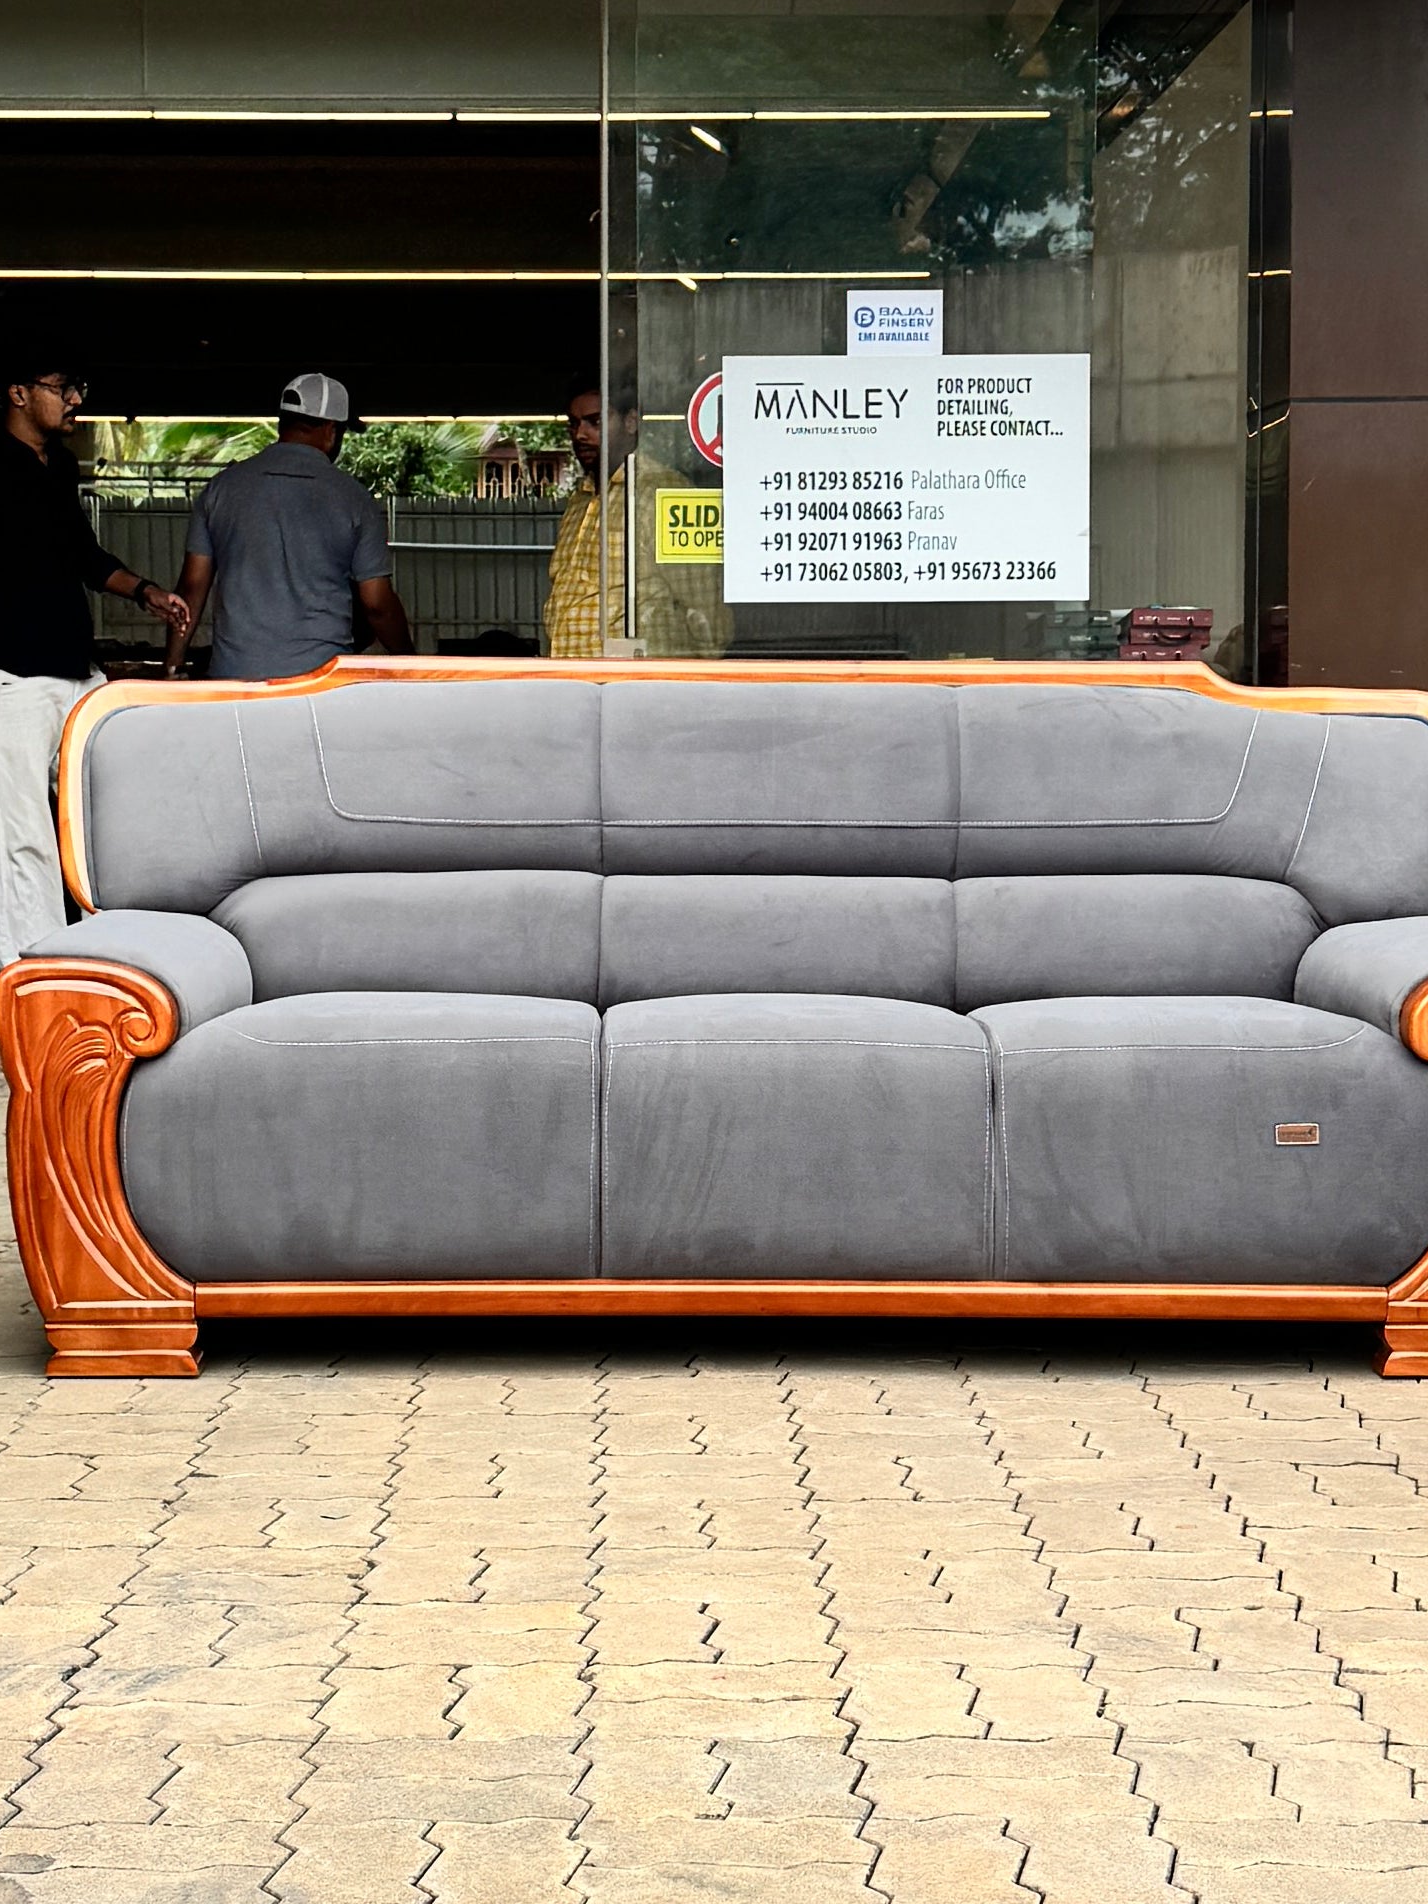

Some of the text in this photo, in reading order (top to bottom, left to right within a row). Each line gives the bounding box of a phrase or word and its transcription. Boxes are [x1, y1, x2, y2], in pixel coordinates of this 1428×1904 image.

[878, 306, 934, 317] BAJAJ
[878, 317, 934, 328] FINSERV
[858, 332, 930, 342] EMI AVAILABLE
[937, 377, 1033, 395] FOR PRODUCT
[754, 388, 909, 420] MANLEY
[937, 398, 1013, 418] DETAILING,
[785, 426, 878, 435] FURNITURE STUDIO
[937, 419, 1064, 437] PLEASE CONTACT...
[759, 468, 1027, 491] +91 81293 85216 Palathara Office
[668, 504, 724, 528] SLID
[759, 500, 945, 521] +91 94004 08663 Faras
[669, 530, 724, 547] TO OPE
[760, 530, 957, 552] +91 92071 91963 Pranav
[760, 560, 1057, 584] +91 73062 05803, +91 95673 23366
